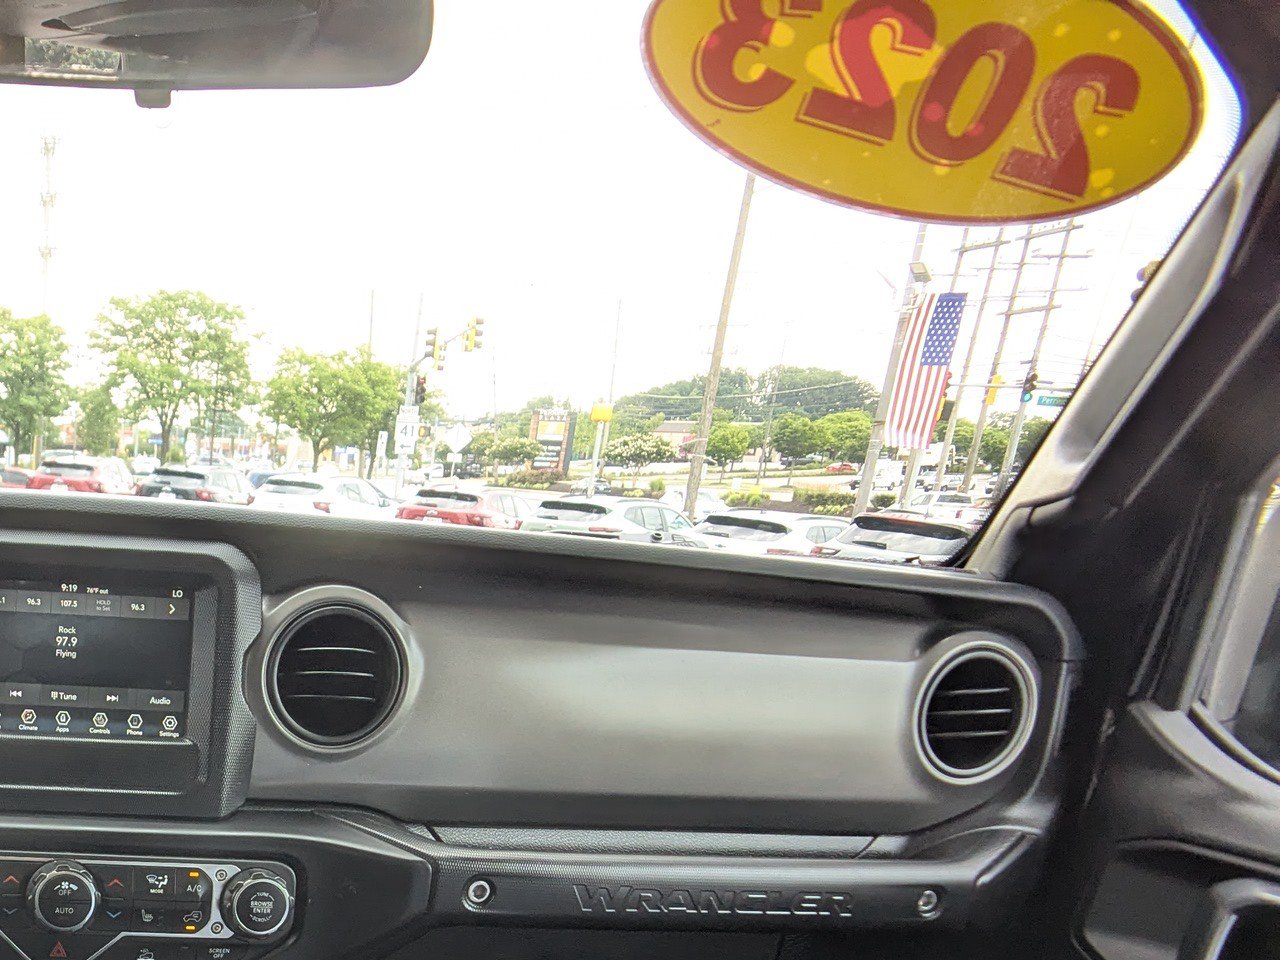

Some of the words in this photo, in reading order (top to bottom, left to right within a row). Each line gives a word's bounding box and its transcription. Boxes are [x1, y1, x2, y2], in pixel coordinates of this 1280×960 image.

[400, 425, 414, 437] 41
[61, 583, 78, 592] 9:19
[172, 589, 183, 598] LO
[60, 600, 78, 608] 107.5
[131, 603, 145, 611] 96.3
[58, 626, 76, 634] Rock
[56, 636, 78, 647] 97.9
[55, 649, 76, 659] Flying
[60, 692, 77, 701] Tune
[149, 697, 171, 705] Audio
[186, 884, 202, 893] A/C
[573, 884, 852, 917] WRANGLER
